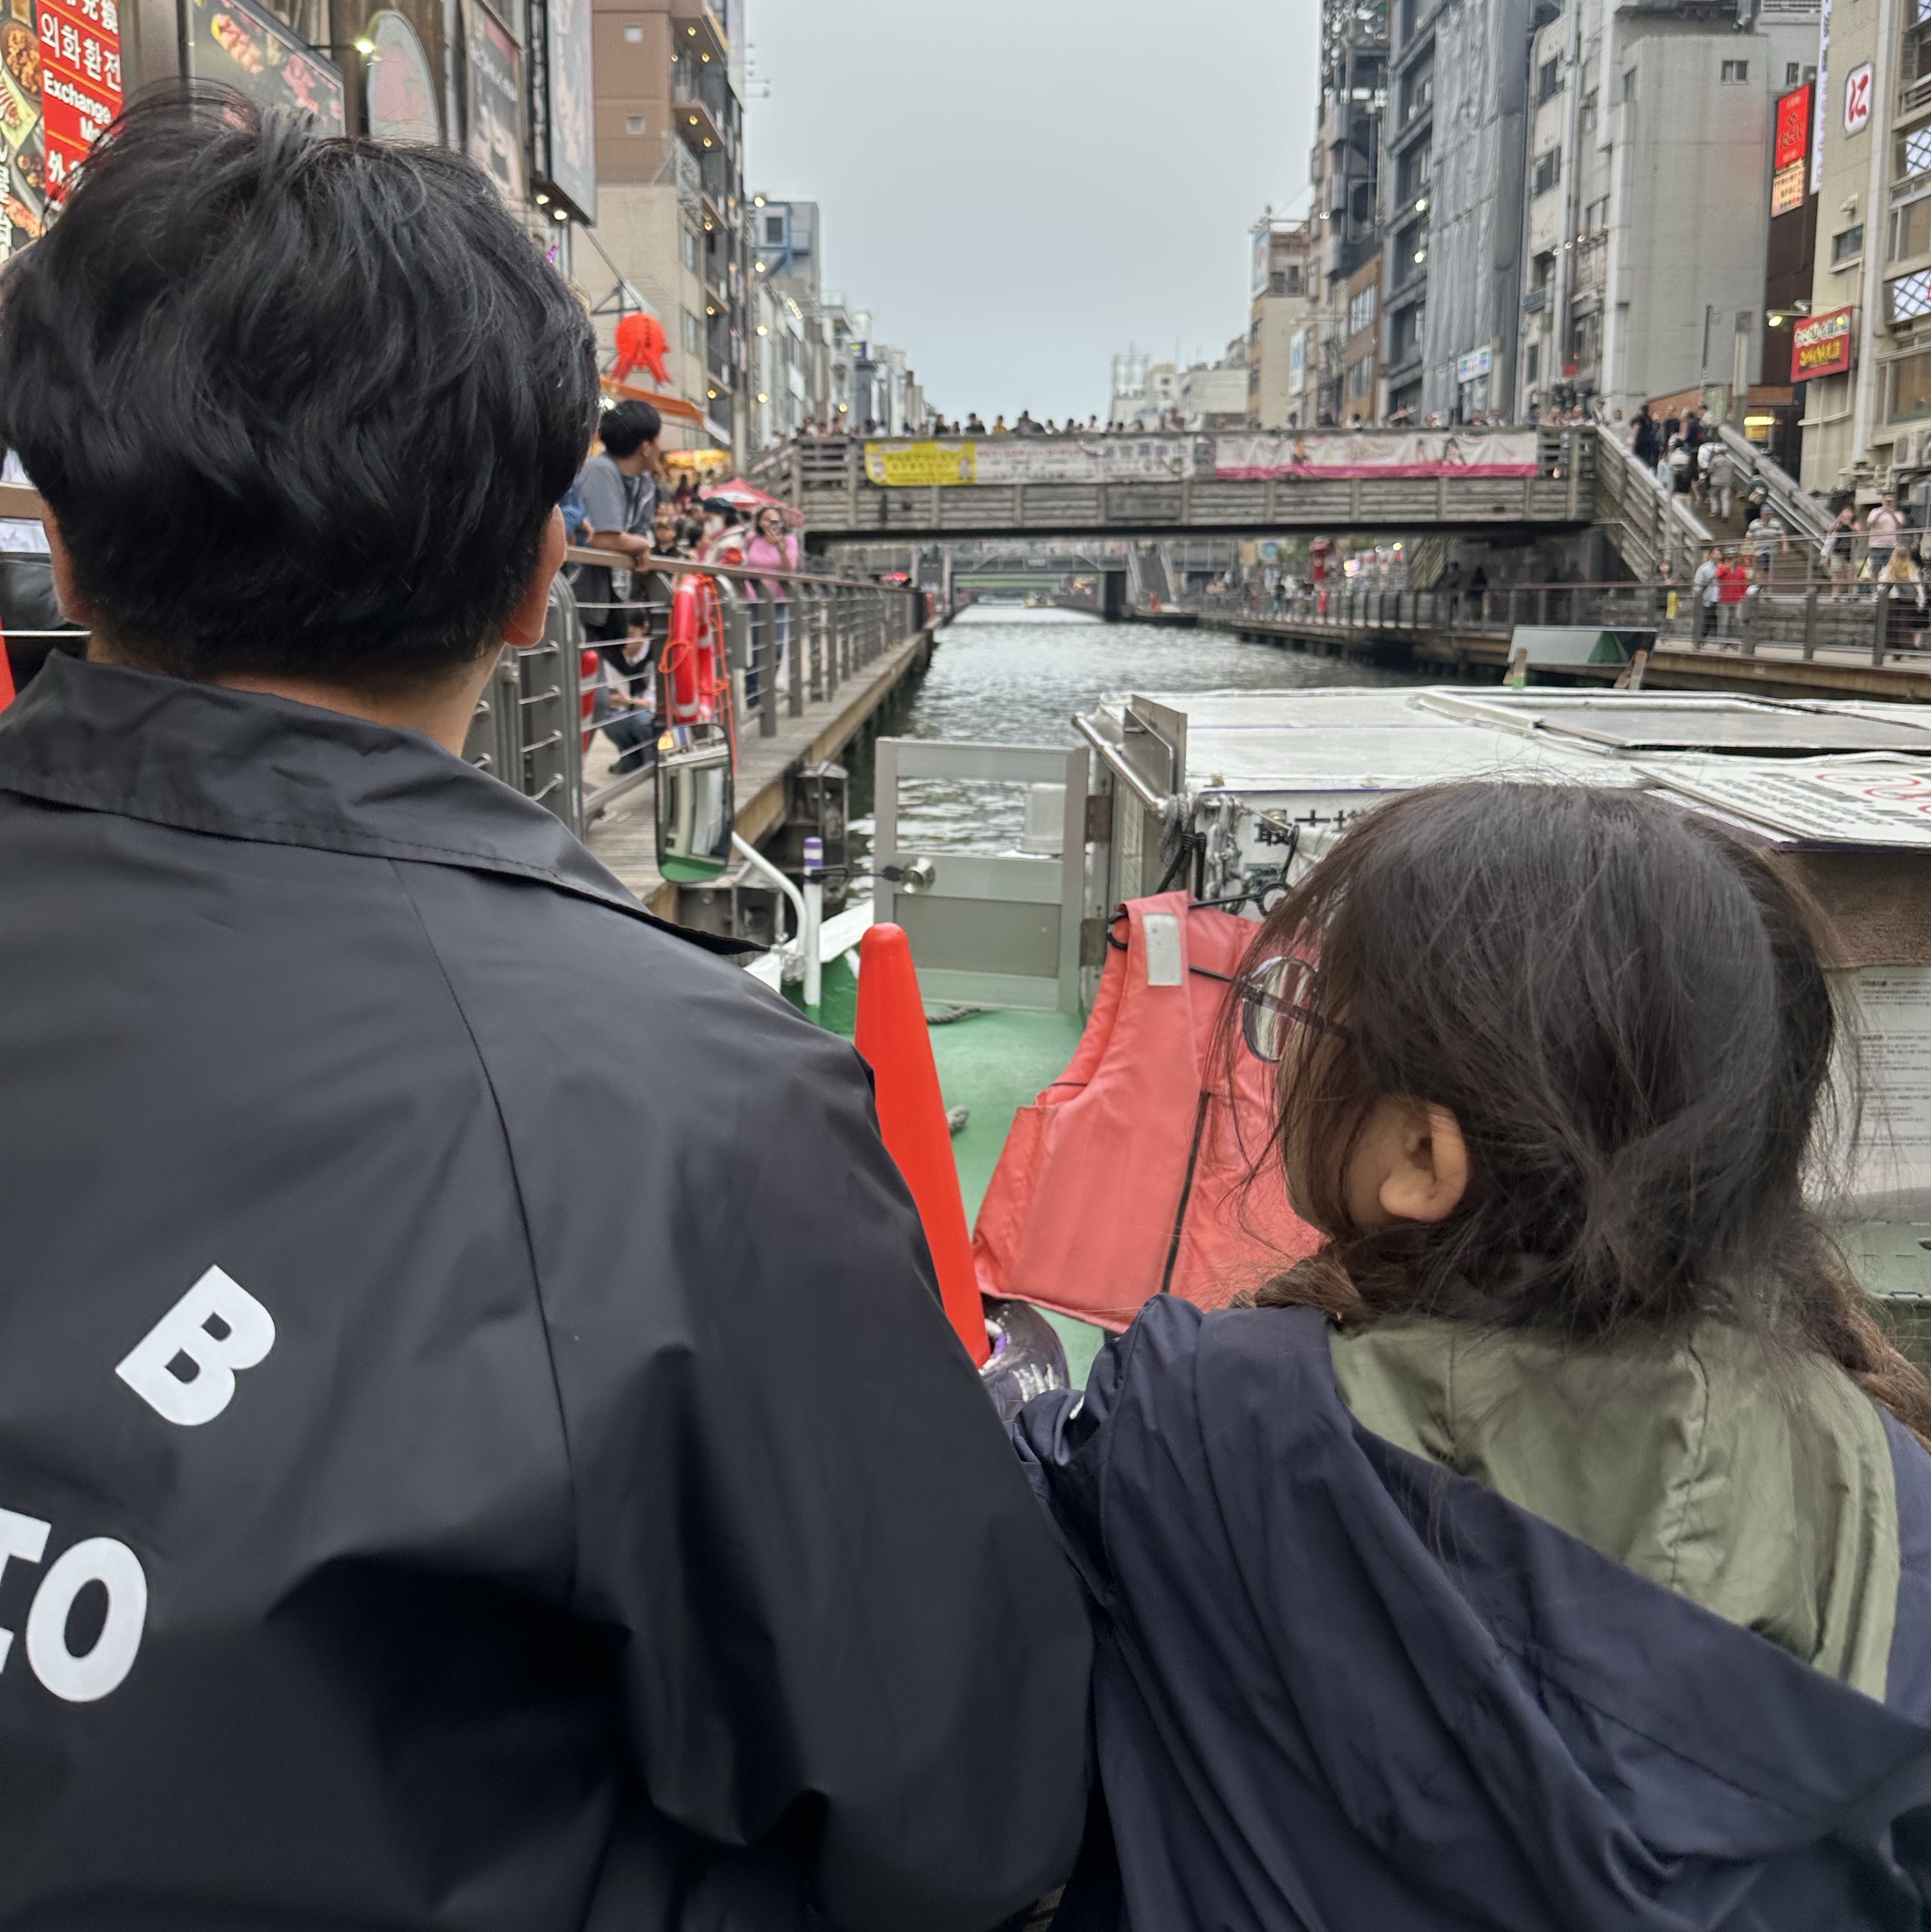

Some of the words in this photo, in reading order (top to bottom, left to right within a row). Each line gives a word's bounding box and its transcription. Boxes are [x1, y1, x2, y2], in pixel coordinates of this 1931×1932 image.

[41, 13, 122, 92] 외화환전
[43, 68, 111, 125] Exchange
[1850, 74, 1868, 122] に
[115, 1264, 276, 1426] B
